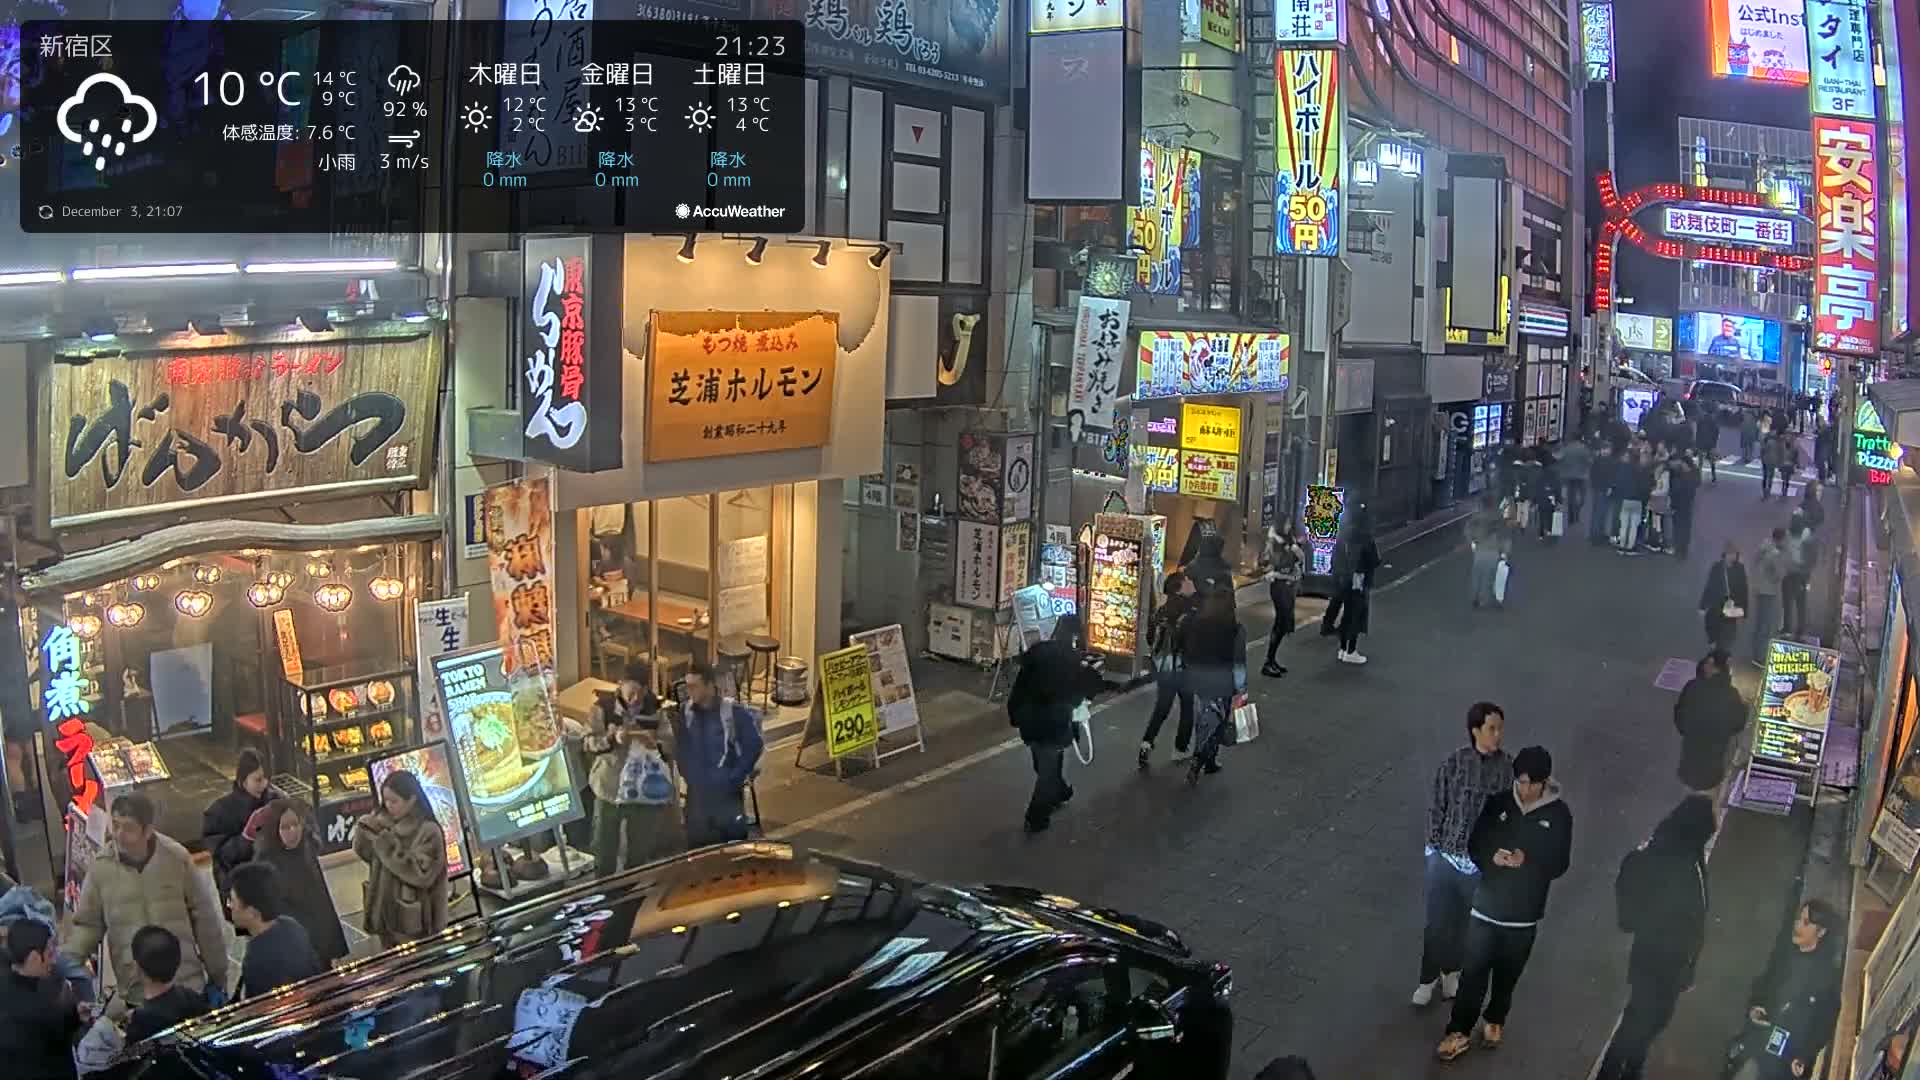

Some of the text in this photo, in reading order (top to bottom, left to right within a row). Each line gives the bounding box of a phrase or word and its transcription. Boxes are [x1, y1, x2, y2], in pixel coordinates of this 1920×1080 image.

[1817, 14, 1842, 70] タイ
[1832, 97, 1856, 111] 3F
[1295, 51, 1321, 190] ハイボール
[1670, 211, 1789, 242] 歌舞伎町一番街
[1817, 126, 1874, 330] 安楽亭
[560, 256, 585, 401] 東京豚骨
[702, 332, 799, 355] もつ焼 煮込み
[1816, 332, 1837, 348] 2F
[525, 256, 587, 450] らーめん
[1087, 308, 1121, 413] お好み焼き
[668, 366, 824, 406] 芝浦ホルモン
[440, 664, 485, 686] TOKYO
[1773, 663, 1818, 674] CHEESE
[445, 680, 487, 698] RAMEN
[833, 713, 864, 744] 290
